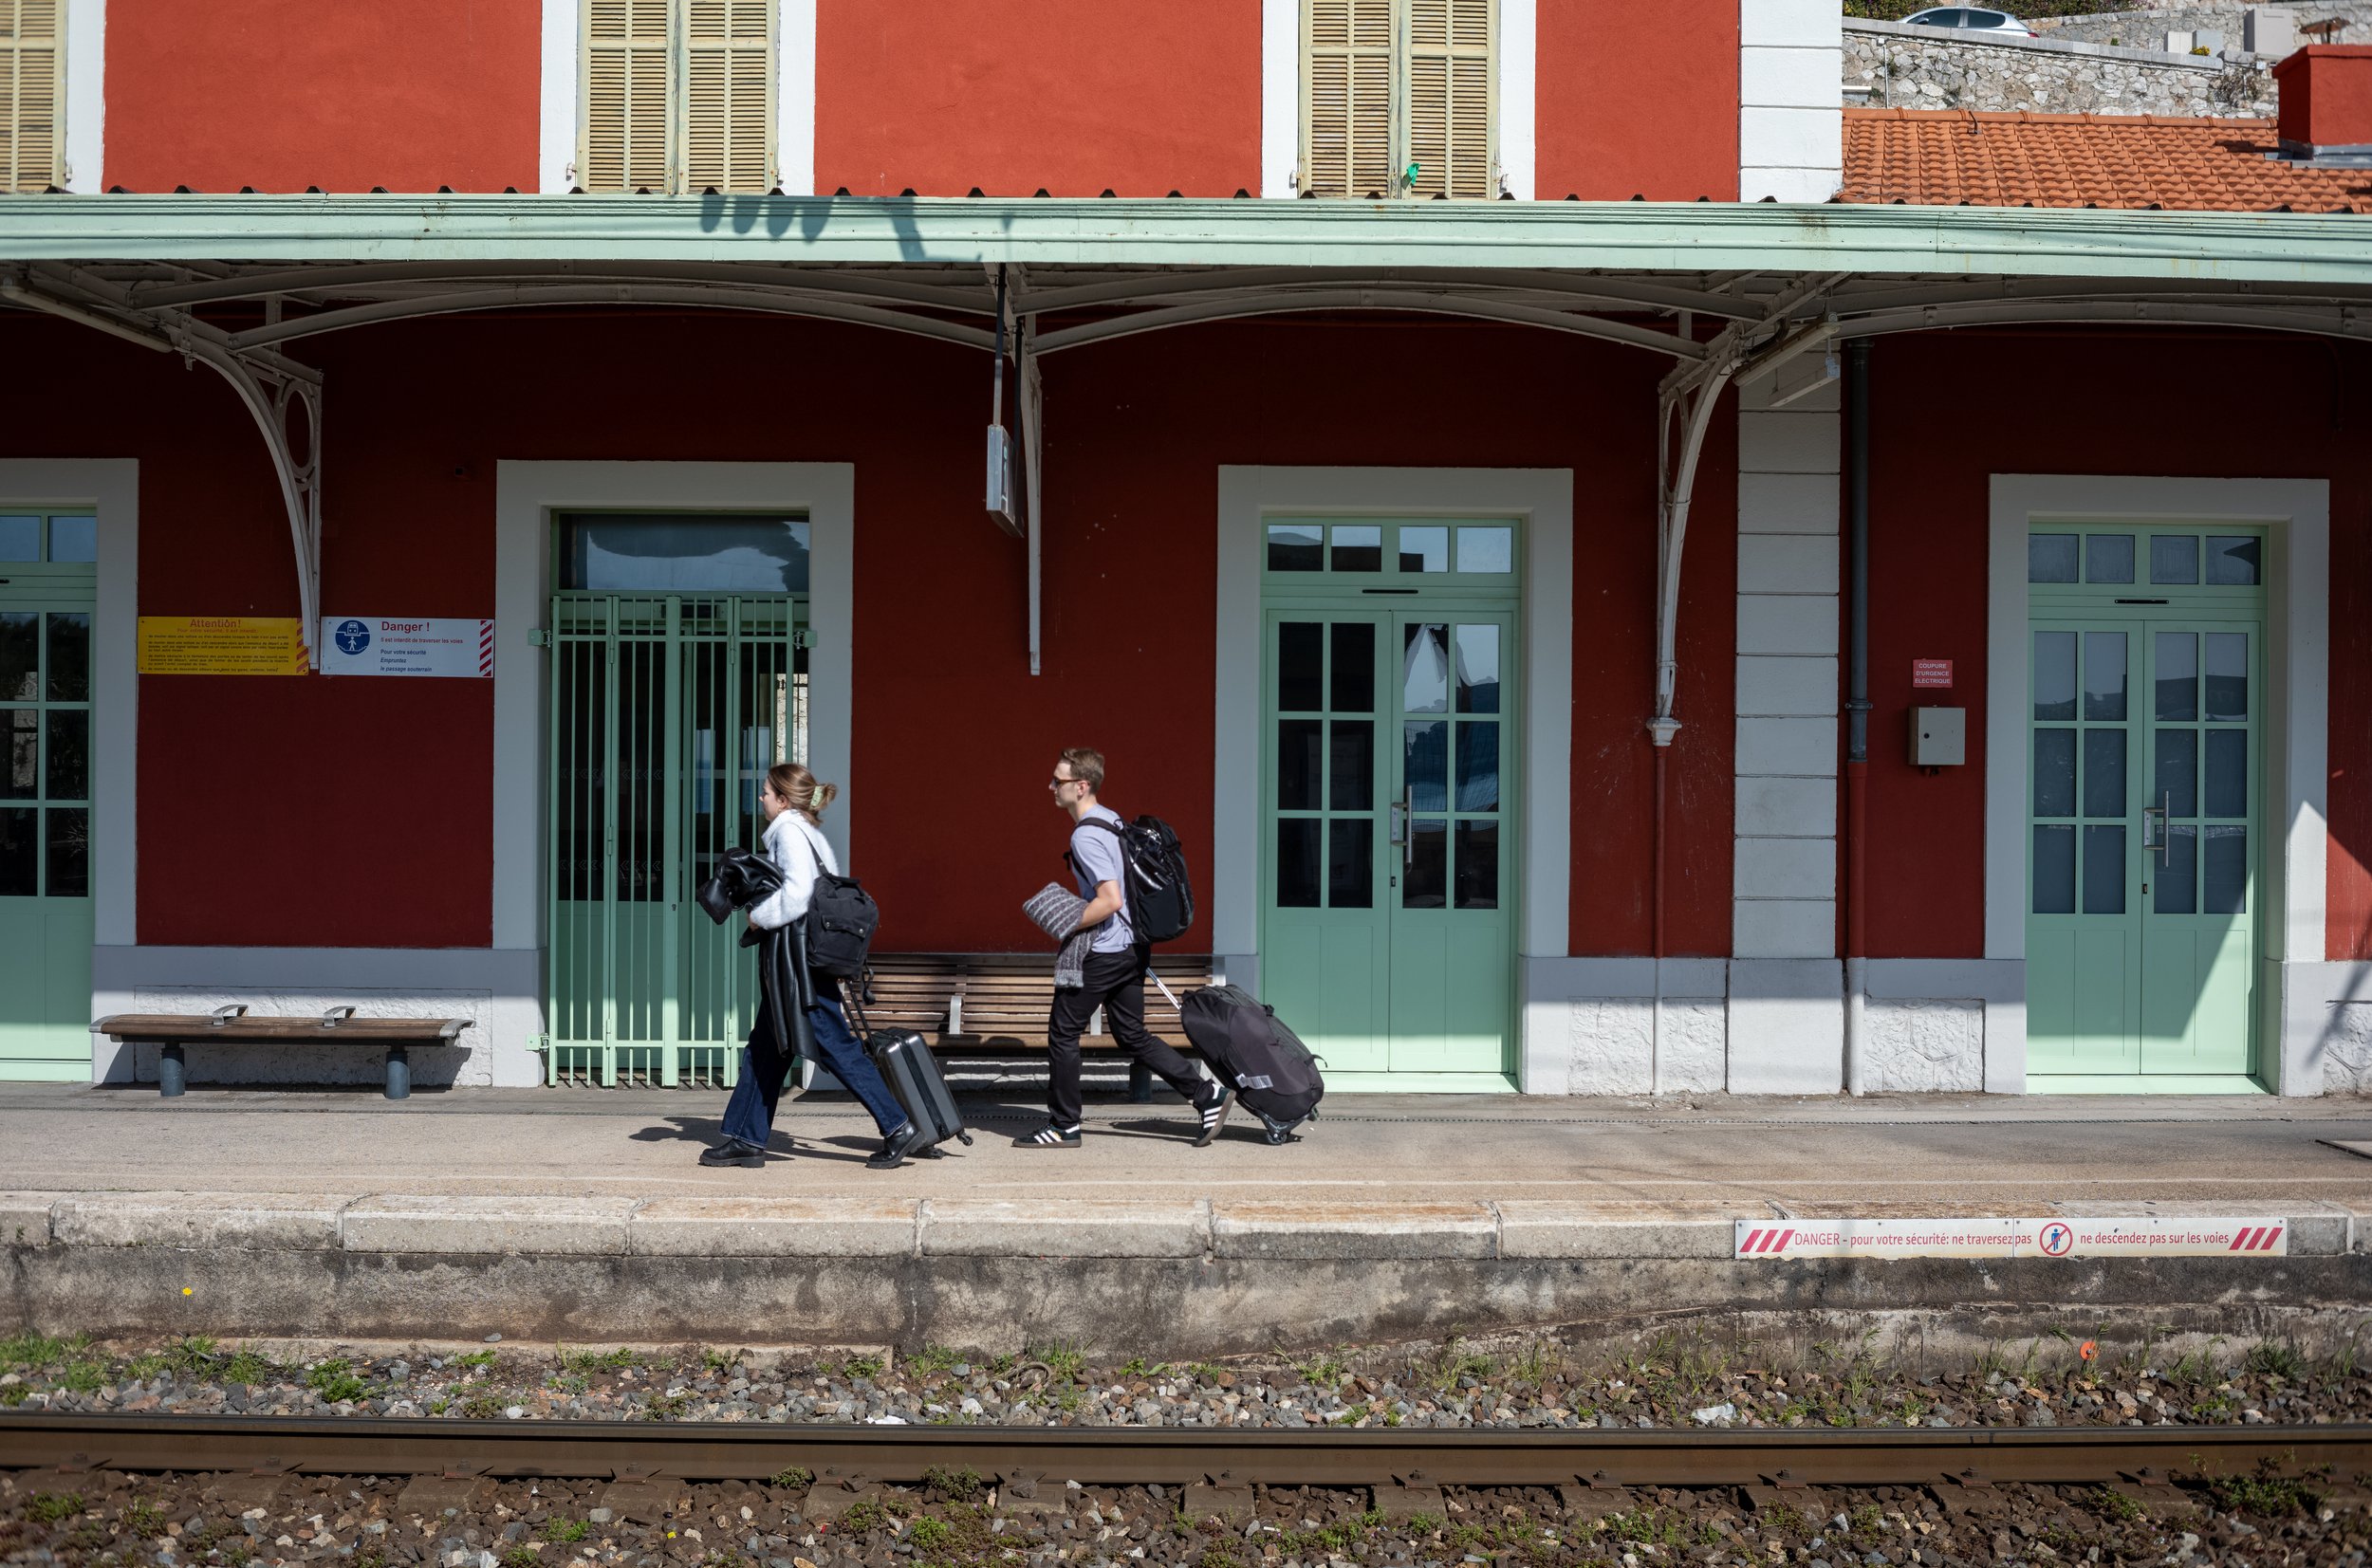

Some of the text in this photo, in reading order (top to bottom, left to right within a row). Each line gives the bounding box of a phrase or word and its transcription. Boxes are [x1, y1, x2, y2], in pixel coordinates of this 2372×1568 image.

[190, 618, 241, 628] Attention!
[381, 621, 430, 634] Danger !
[1795, 1232, 1840, 1245] DANGER
[1850, 1236, 1874, 1248] pour
[1877, 1234, 1903, 1245] votre
[1906, 1232, 1949, 1245] sécurité:
[1952, 1235, 1964, 1245] ne
[1967, 1234, 2012, 1245] traversez
[2015, 1235, 2032, 1247] pas
[2080, 1234, 2092, 1244] ne
[2095, 1232, 2147, 1244] descendez
[2149, 1234, 2166, 1247] pas
[2169, 1234, 2185, 1244] sur
[2187, 1231, 2201, 1244] les
[2203, 1231, 2229, 1244] voies
